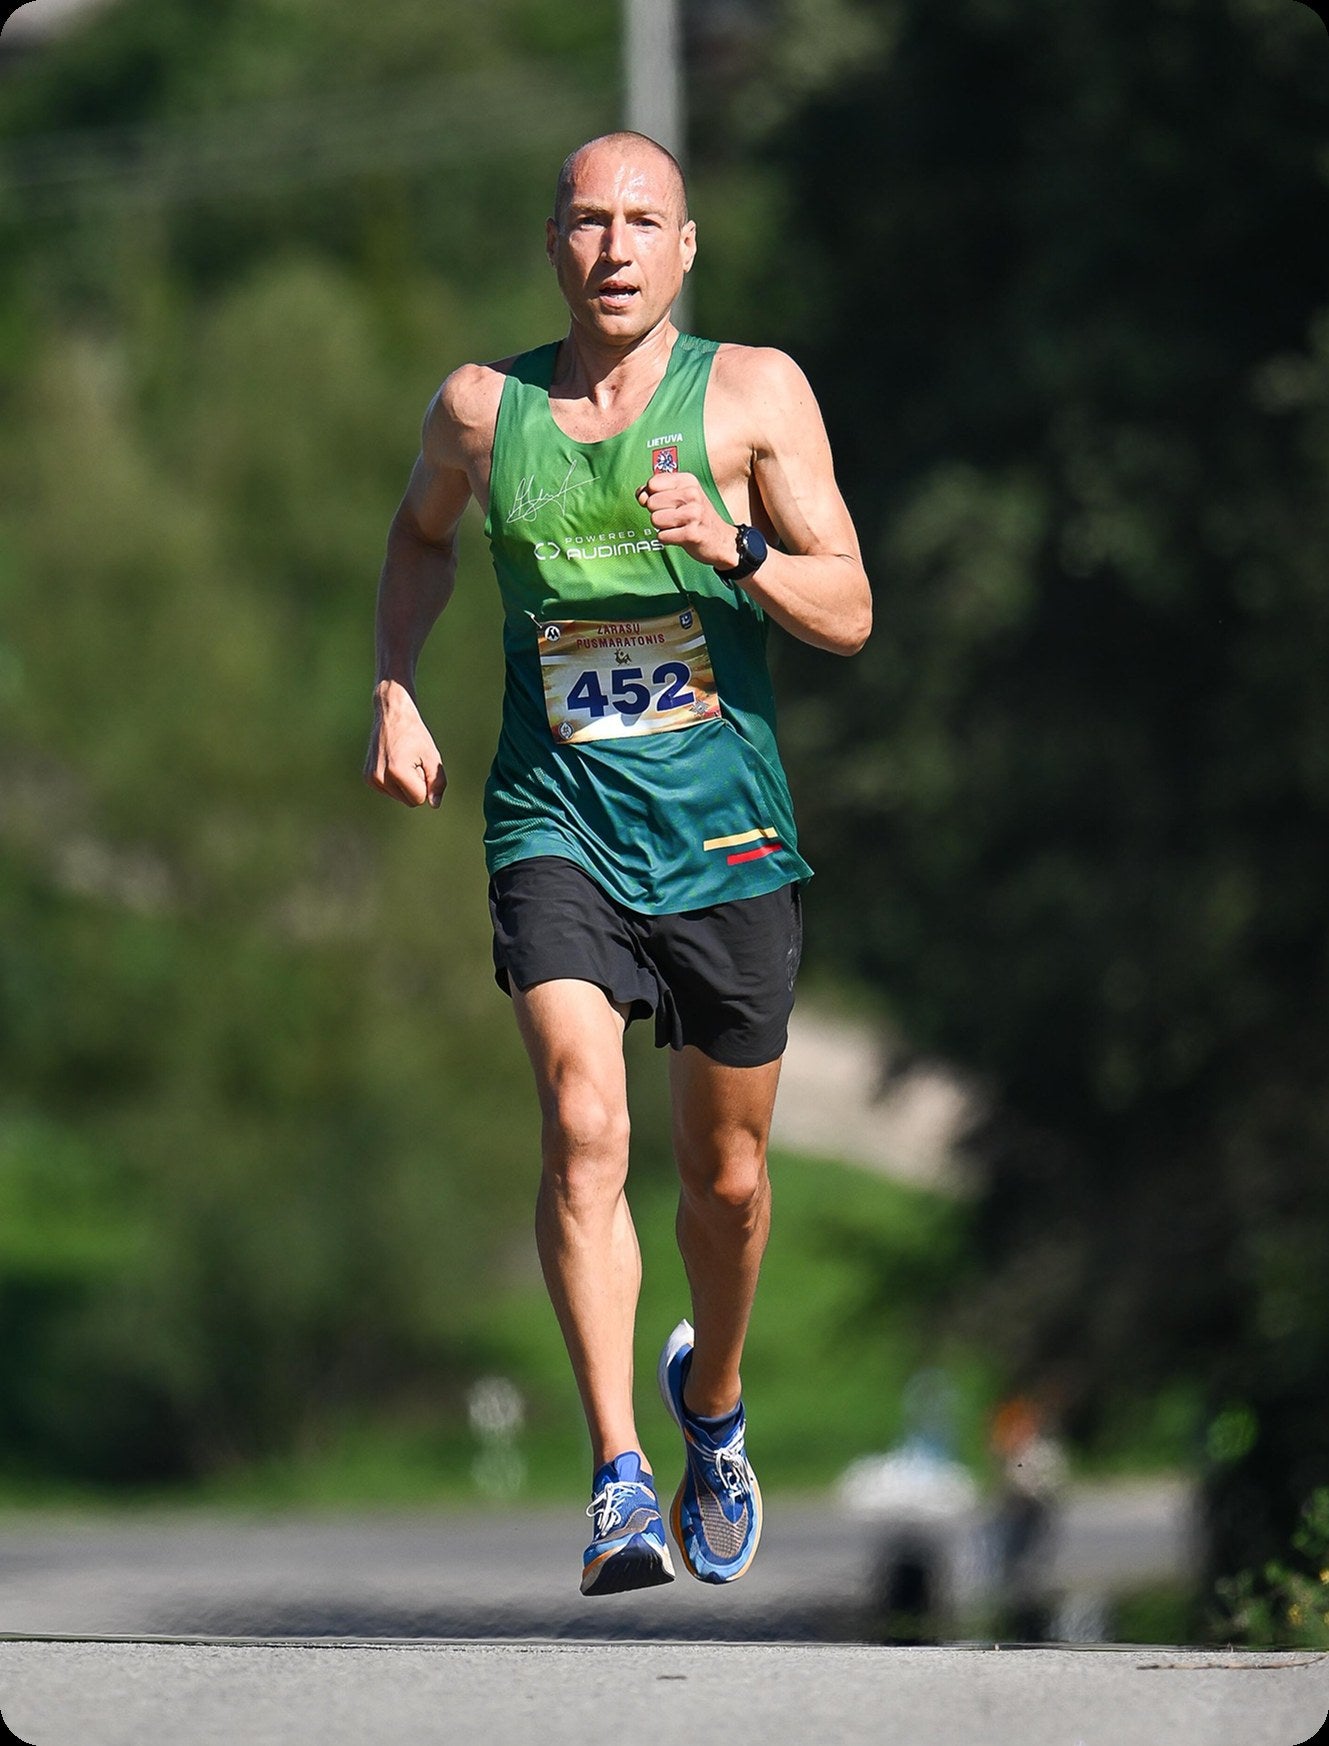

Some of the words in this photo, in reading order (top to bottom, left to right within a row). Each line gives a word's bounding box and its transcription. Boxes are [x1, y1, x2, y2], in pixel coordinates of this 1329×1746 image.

[646, 433, 683, 448] LIETUVA
[564, 530, 635, 545] POWERED
[566, 539, 665, 561] AUDIMAS
[576, 633, 666, 649] PUSMARATONIS
[566, 660, 696, 718] 452
